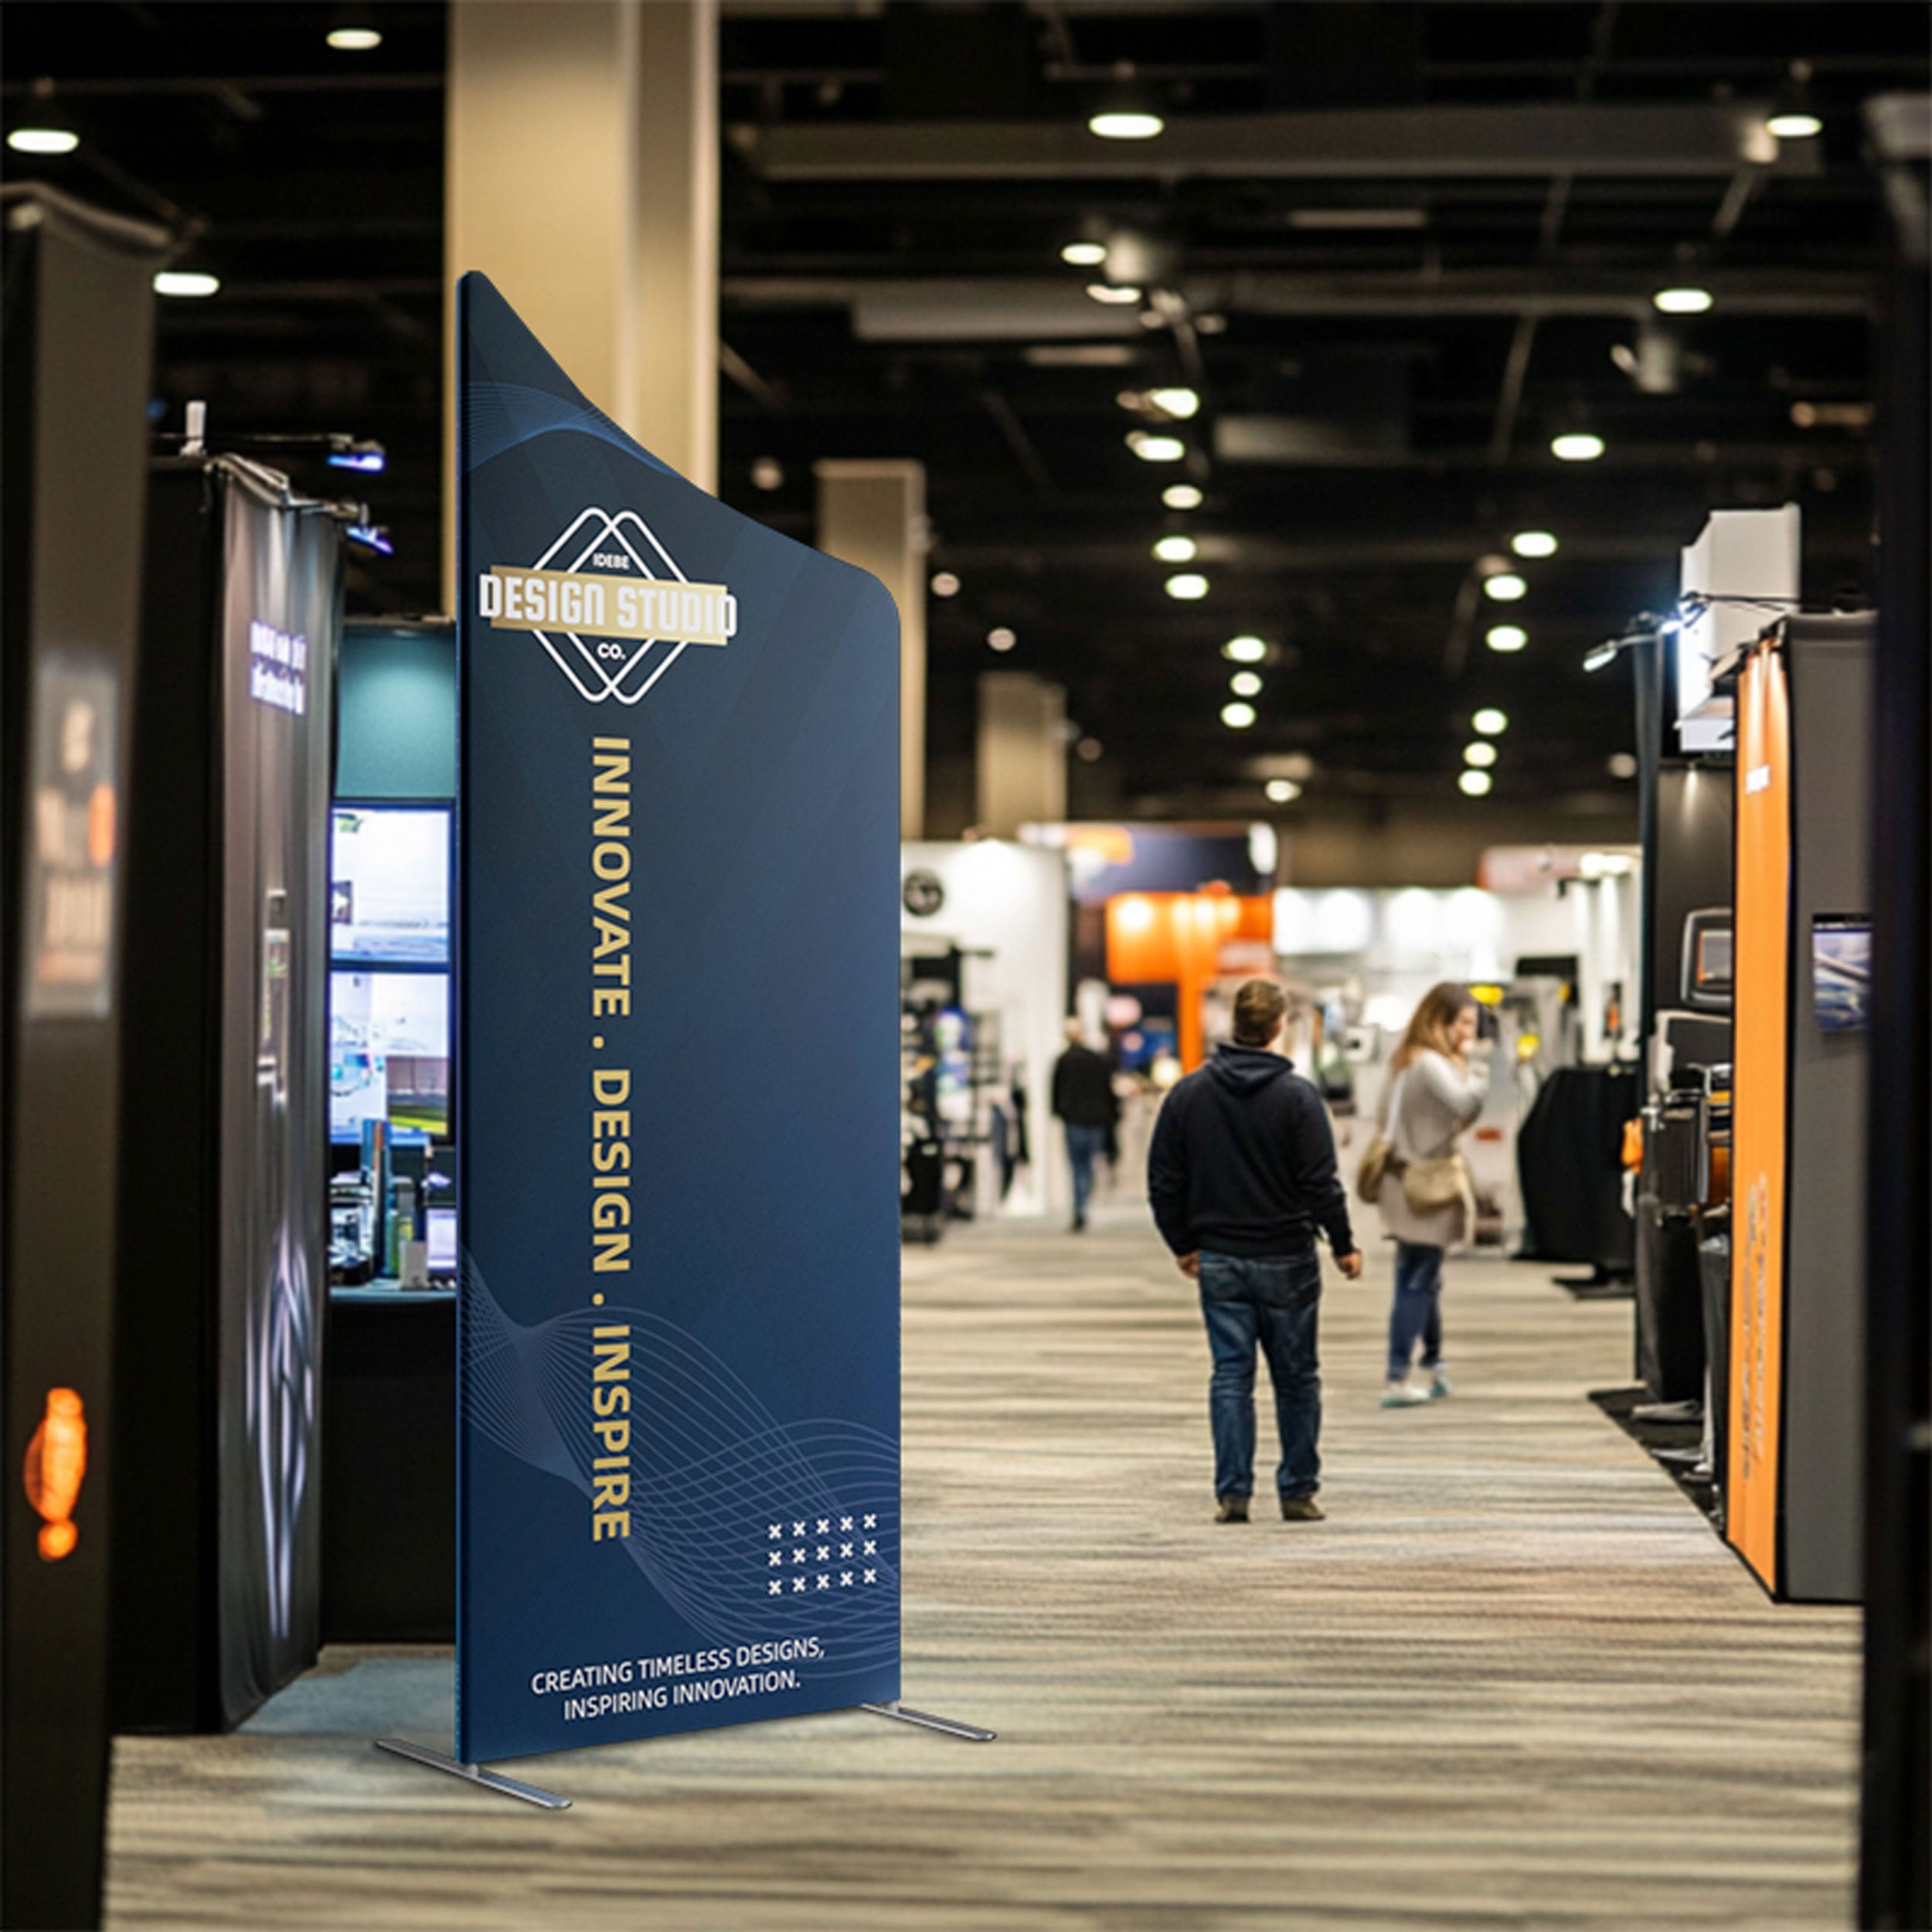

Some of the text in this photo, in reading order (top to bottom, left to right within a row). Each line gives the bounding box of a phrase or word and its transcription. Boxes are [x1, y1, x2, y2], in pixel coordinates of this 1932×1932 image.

[479, 574, 737, 637] DESIGN STUDIO
[597, 642, 626, 662] CO.
[593, 736, 631, 1016] INNOVATE
[593, 1069, 631, 1271] DESIGN
[593, 1325, 631, 1541] INSPIRE
[530, 1636, 825, 1695] CREATING TIMELESS DESIGNS,
[564, 1670, 800, 1720] INSPIRING INNOVATION.
